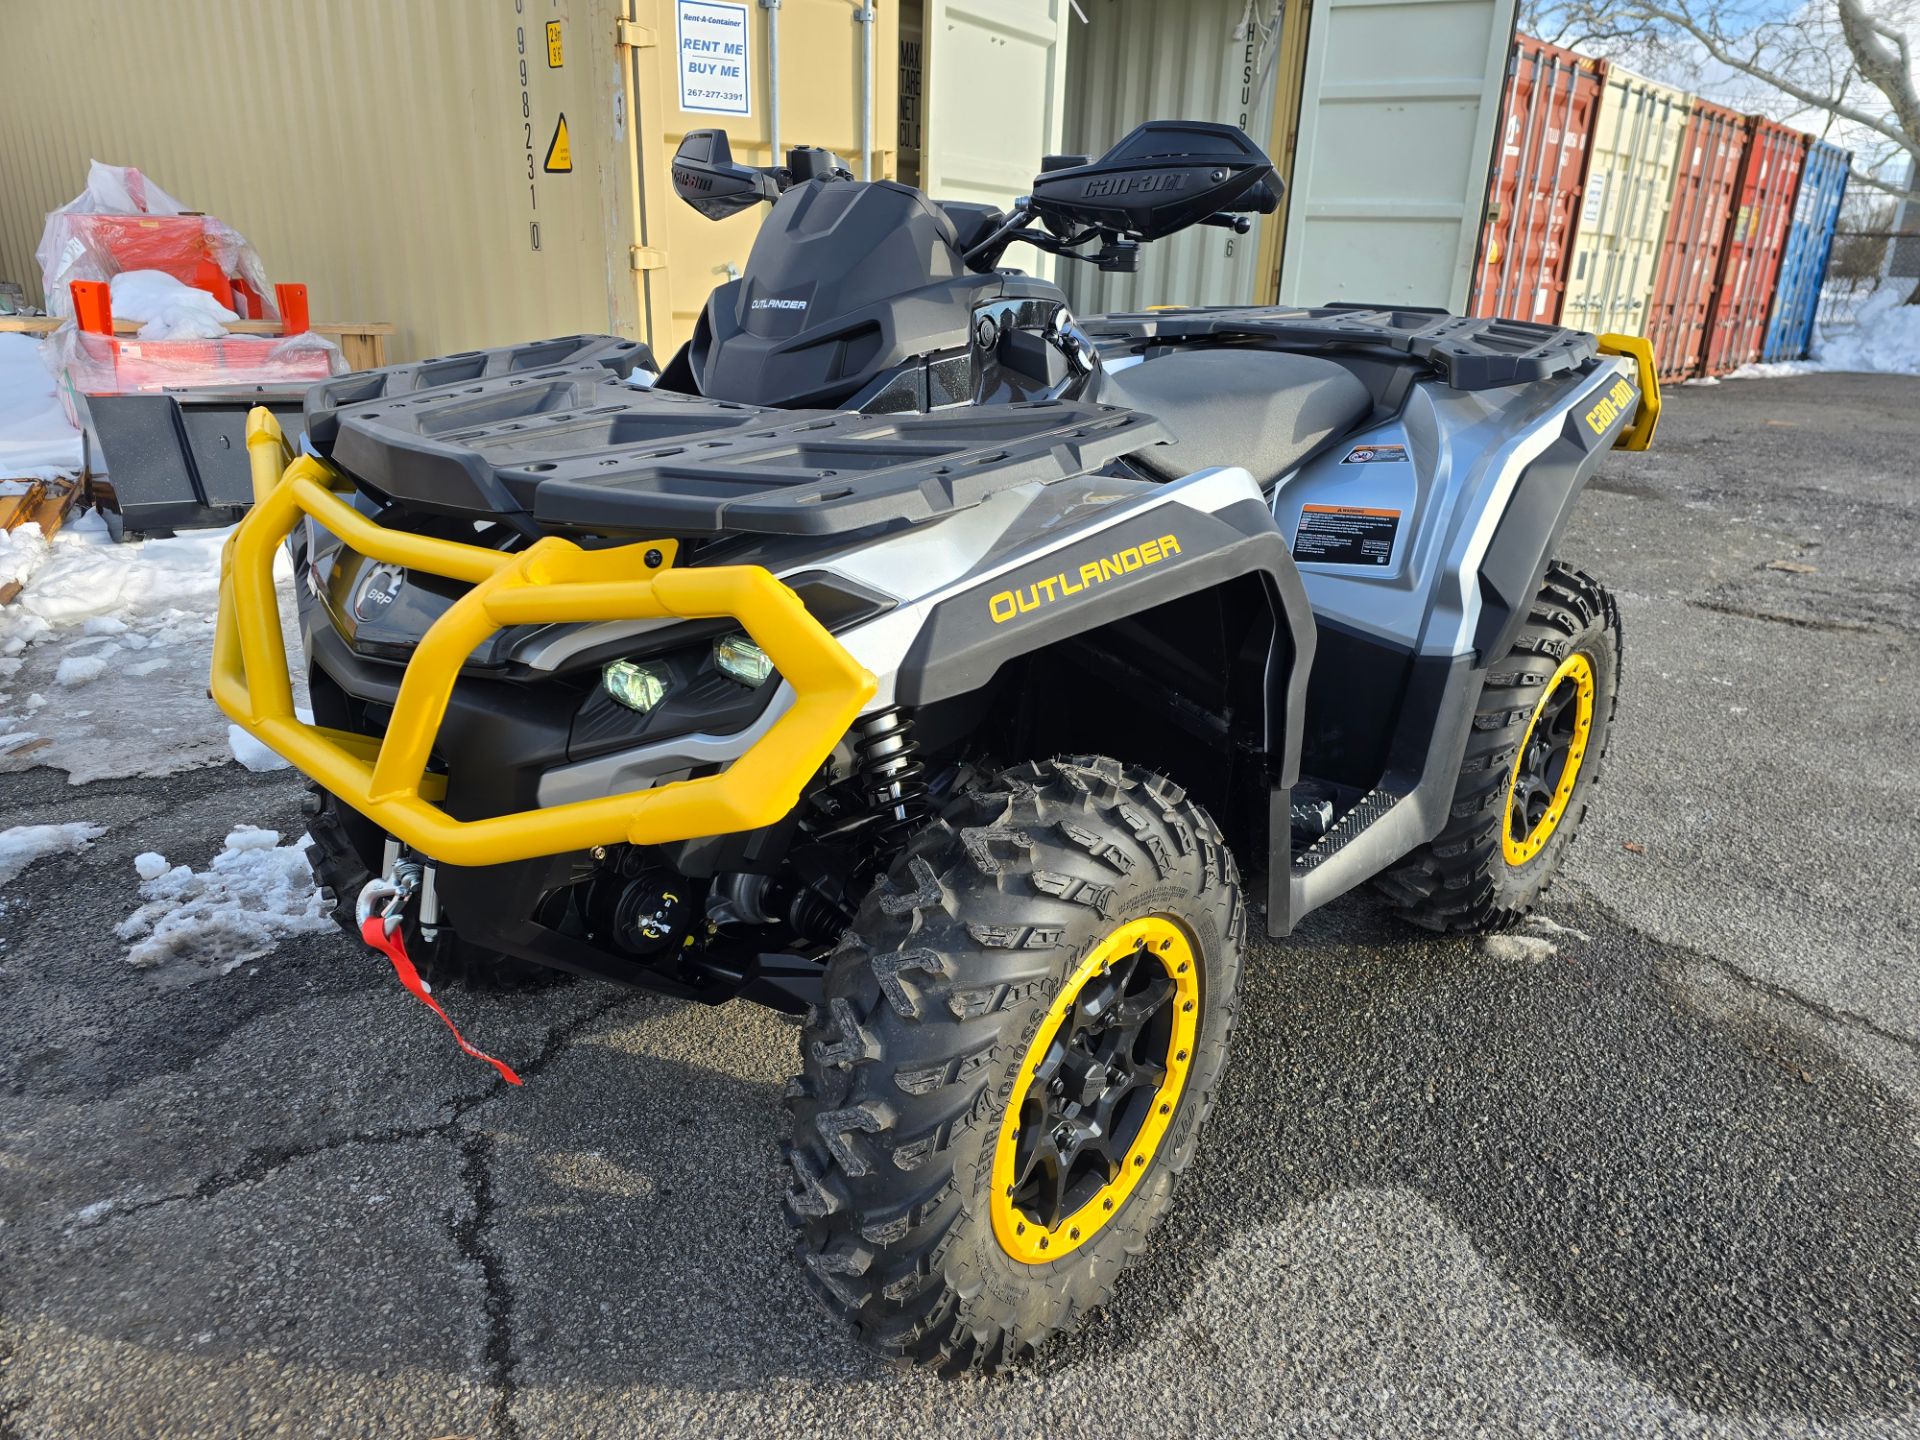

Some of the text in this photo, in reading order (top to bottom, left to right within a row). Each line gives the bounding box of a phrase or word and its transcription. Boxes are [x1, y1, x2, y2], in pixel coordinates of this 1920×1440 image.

[683, 13, 742, 28] Rent-A-Container
[683, 38, 744, 56] RENT ME
[900, 40, 920, 69] MAX
[688, 62, 740, 78] BUY ME
[1241, 23, 1256, 105] HESU
[900, 67, 921, 96] TARE
[687, 88, 743, 101] 267-277-3391
[900, 95, 916, 122] NET
[751, 299, 807, 310] OUTLANDER
[988, 534, 1182, 624] OUTLANDER
[367, 588, 393, 605] BRP
